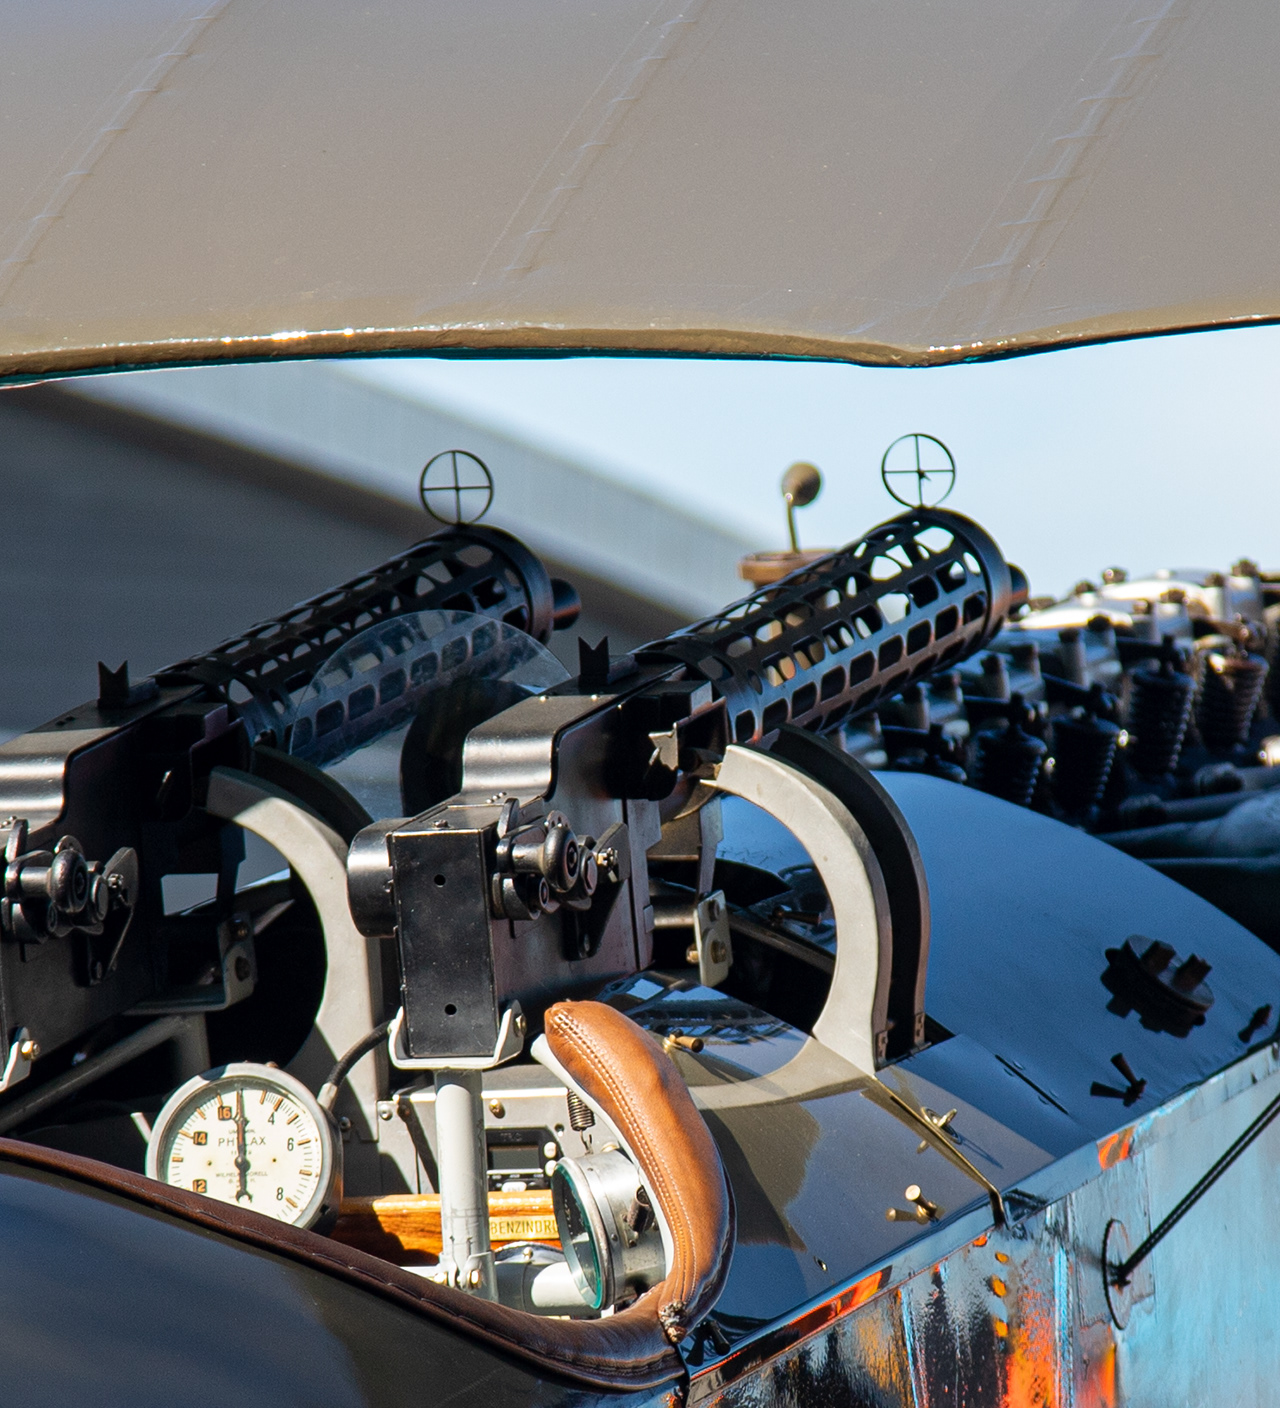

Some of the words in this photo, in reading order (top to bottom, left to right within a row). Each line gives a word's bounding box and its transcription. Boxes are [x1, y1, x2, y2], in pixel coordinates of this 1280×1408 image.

[218, 1107, 231, 1120] 16
[267, 1112, 275, 1125] 4
[194, 1132, 207, 1145] 14
[218, 1136, 266, 1147] PHAX
[287, 1138, 294, 1151] 6
[193, 1180, 206, 1193] 12
[276, 1187, 284, 1201] 8
